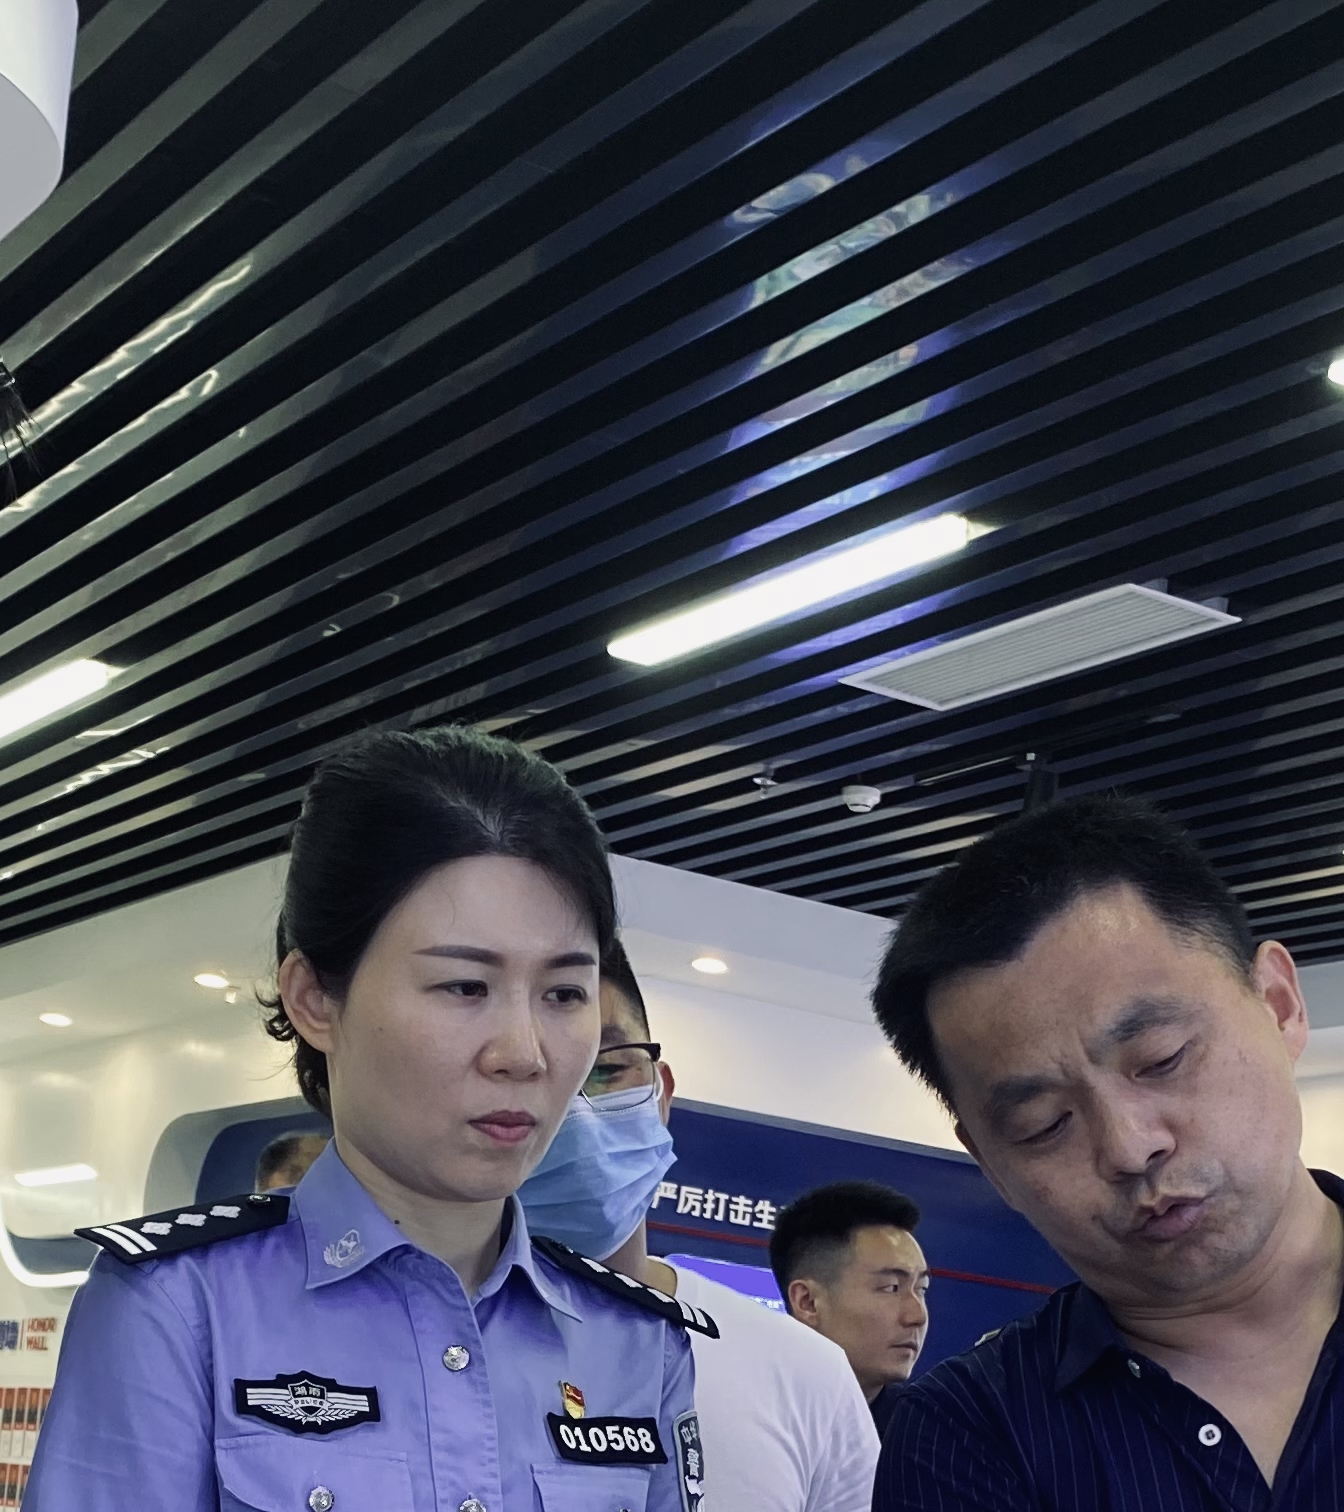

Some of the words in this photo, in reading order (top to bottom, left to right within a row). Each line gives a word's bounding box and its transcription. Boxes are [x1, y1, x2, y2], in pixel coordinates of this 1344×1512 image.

[651, 1181, 786, 1230] 严厉打击生
[559, 1424, 656, 1454] 010568
